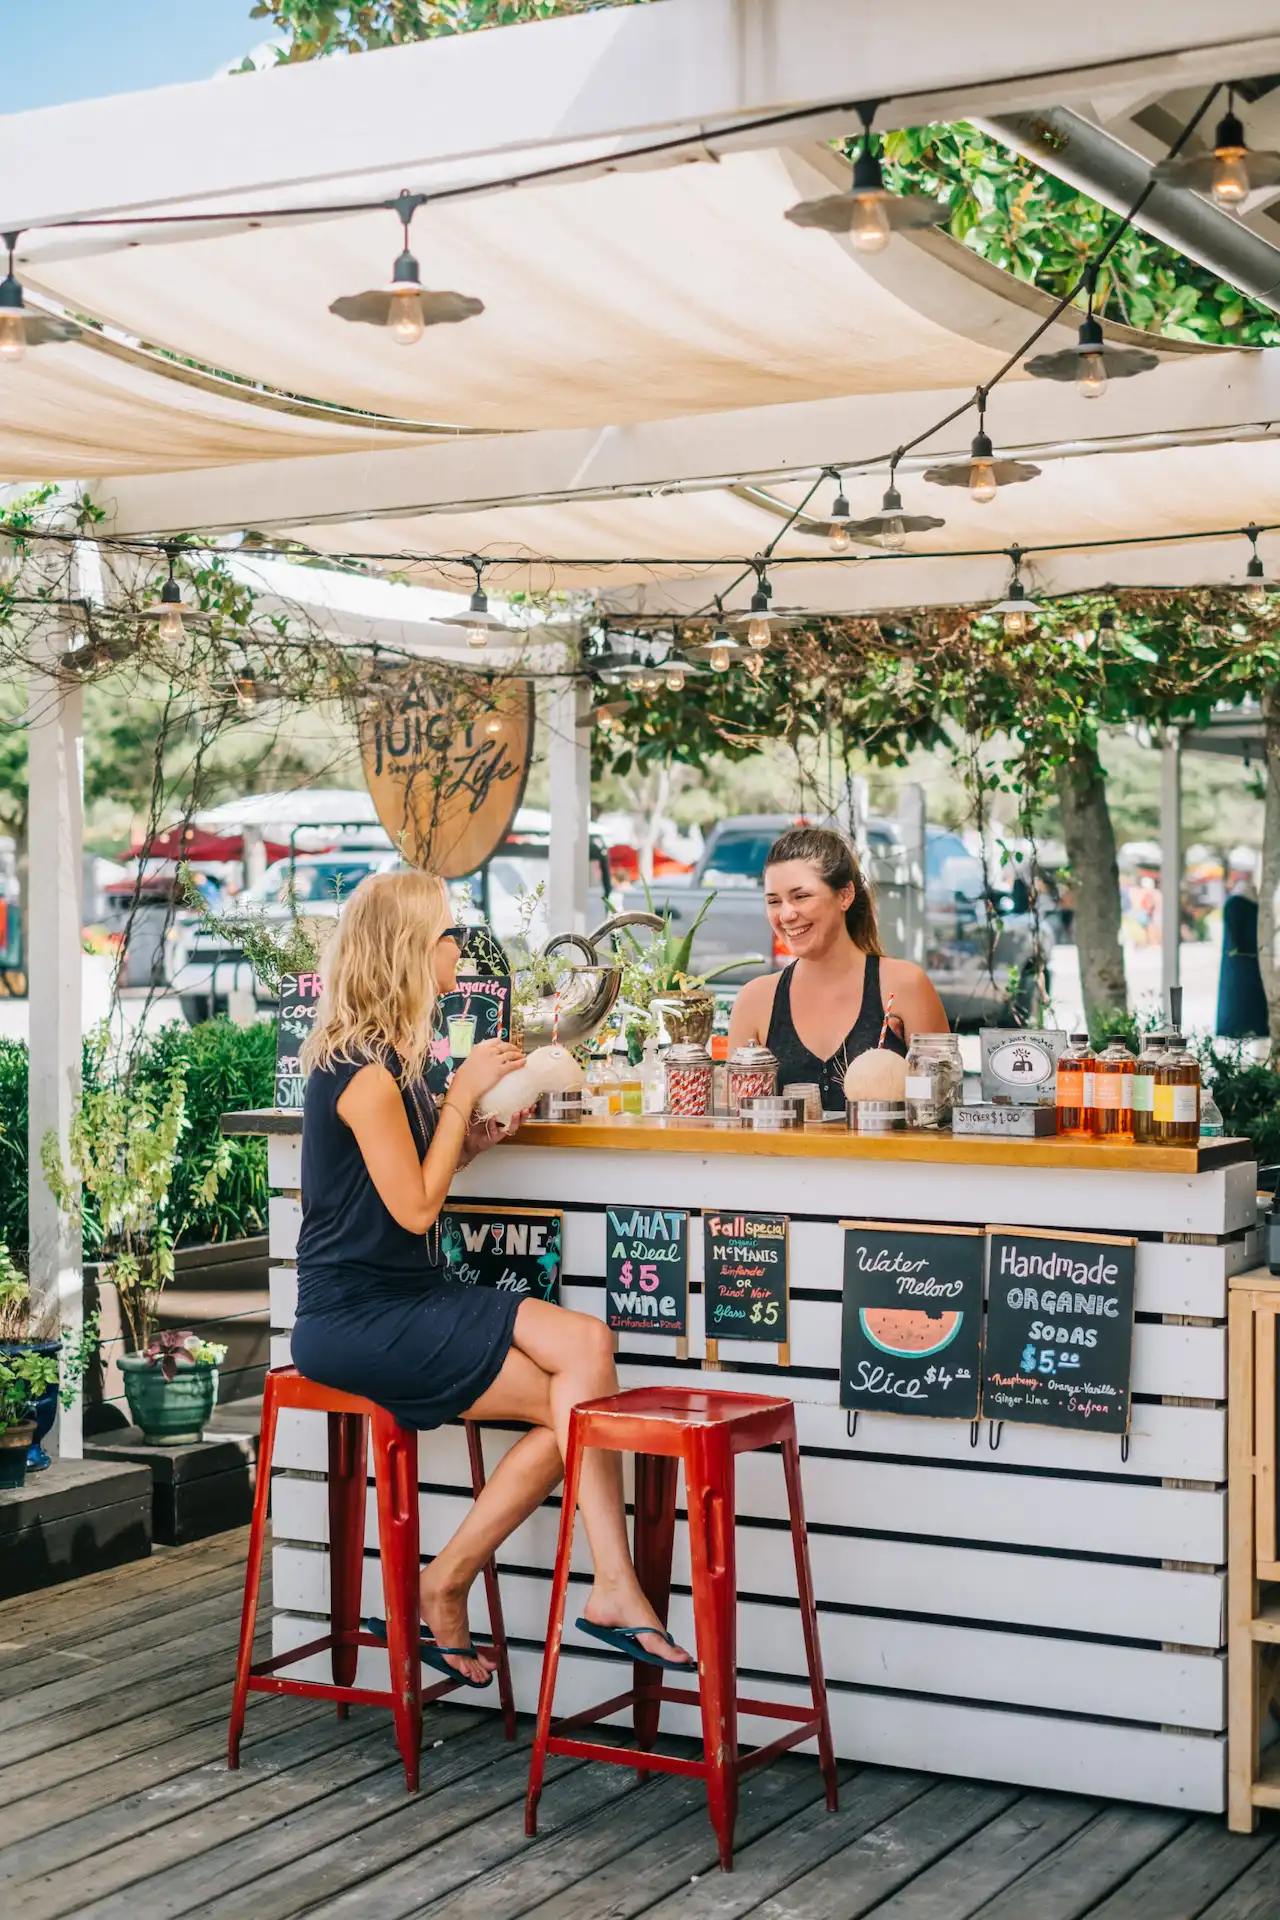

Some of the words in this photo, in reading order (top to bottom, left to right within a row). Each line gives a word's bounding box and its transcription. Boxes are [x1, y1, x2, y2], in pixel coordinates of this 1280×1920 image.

[445, 739, 520, 813] Life
[440, 980, 508, 1000] argarita
[607, 1210, 687, 1240] WHAT
[708, 1216, 745, 1238] Fall
[612, 1242, 627, 1259] A
[630, 1240, 681, 1262] Deal
[857, 1247, 929, 1273] Water
[720, 1265, 765, 1278] Zinfandel
[1000, 1246, 1118, 1285] Handmade
[496, 1268, 531, 1293] the
[718, 1285, 744, 1298] Pinot
[750, 1287, 772, 1299] Noir
[736, 1279, 752, 1288] OR
[749, 1302, 779, 1325] $5
[1007, 1287, 1119, 1318] ORGANIC
[610, 1315, 654, 1329] Zinfandel
[1028, 1321, 1098, 1348] SODAS
[850, 1361, 928, 1399] Slice
[994, 1392, 1022, 1407] Ginger
[1025, 1394, 1049, 1406] Lime
[1067, 1397, 1109, 1418] Safron
